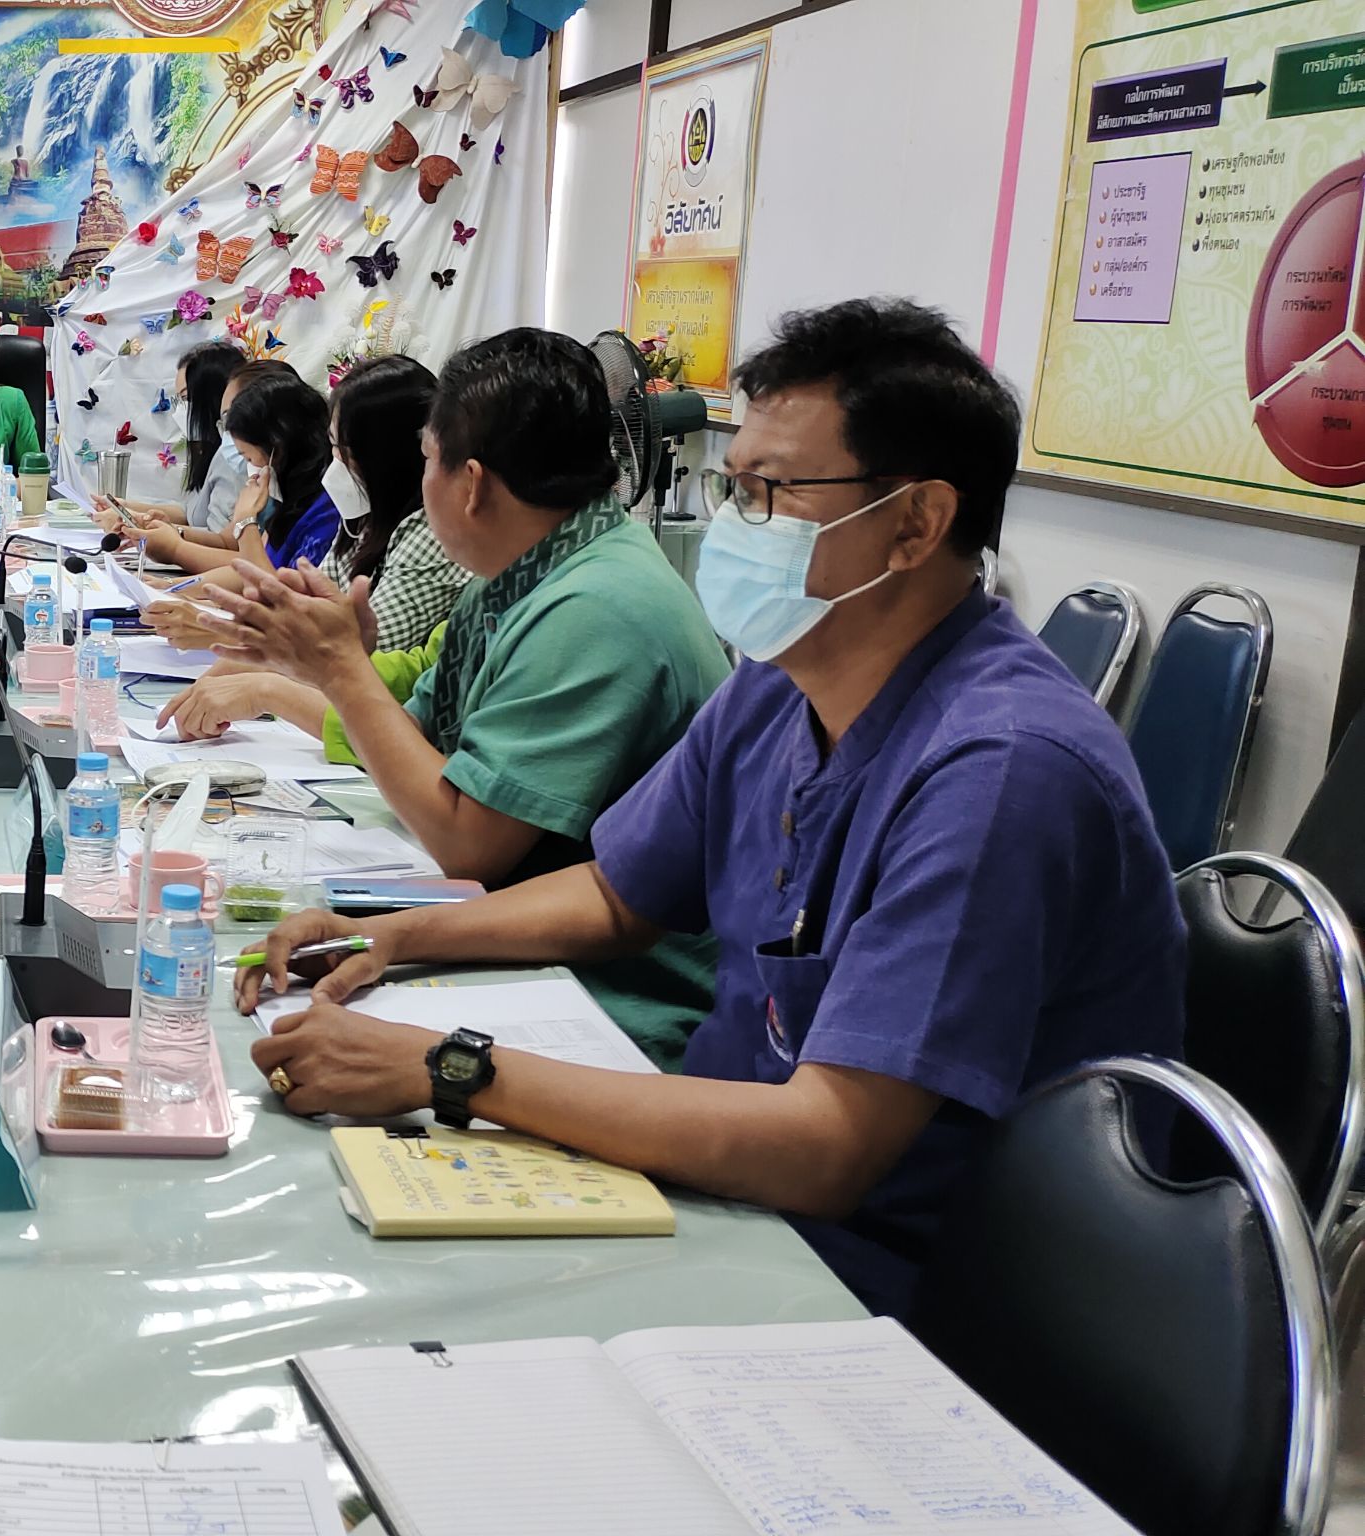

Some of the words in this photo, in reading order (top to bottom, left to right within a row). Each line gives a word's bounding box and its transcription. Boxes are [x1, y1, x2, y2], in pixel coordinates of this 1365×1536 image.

[1124, 83, 1185, 104] กลไกการพัฒนา
[1211, 150, 1285, 174] เศรษฐกิจพอเพียง
[1113, 181, 1147, 201] ประชารัฐ
[1208, 183, 1245, 202] ทุนชุมชน
[665, 195, 723, 234] วิสัยทัศน์
[1110, 209, 1148, 227] ผู้นำชุมชน
[1205, 204, 1275, 225] มุ่งอนาคตร่วมกัน
[1107, 233, 1148, 248] อาสาสมัคร
[1201, 231, 1240, 250] พึ่งตนเอง
[1103, 256, 1149, 276] กลุ่ม/องค์กร
[1100, 285, 1133, 297] เครือข่าย
[1282, 296, 1333, 312] การพัฒนา
